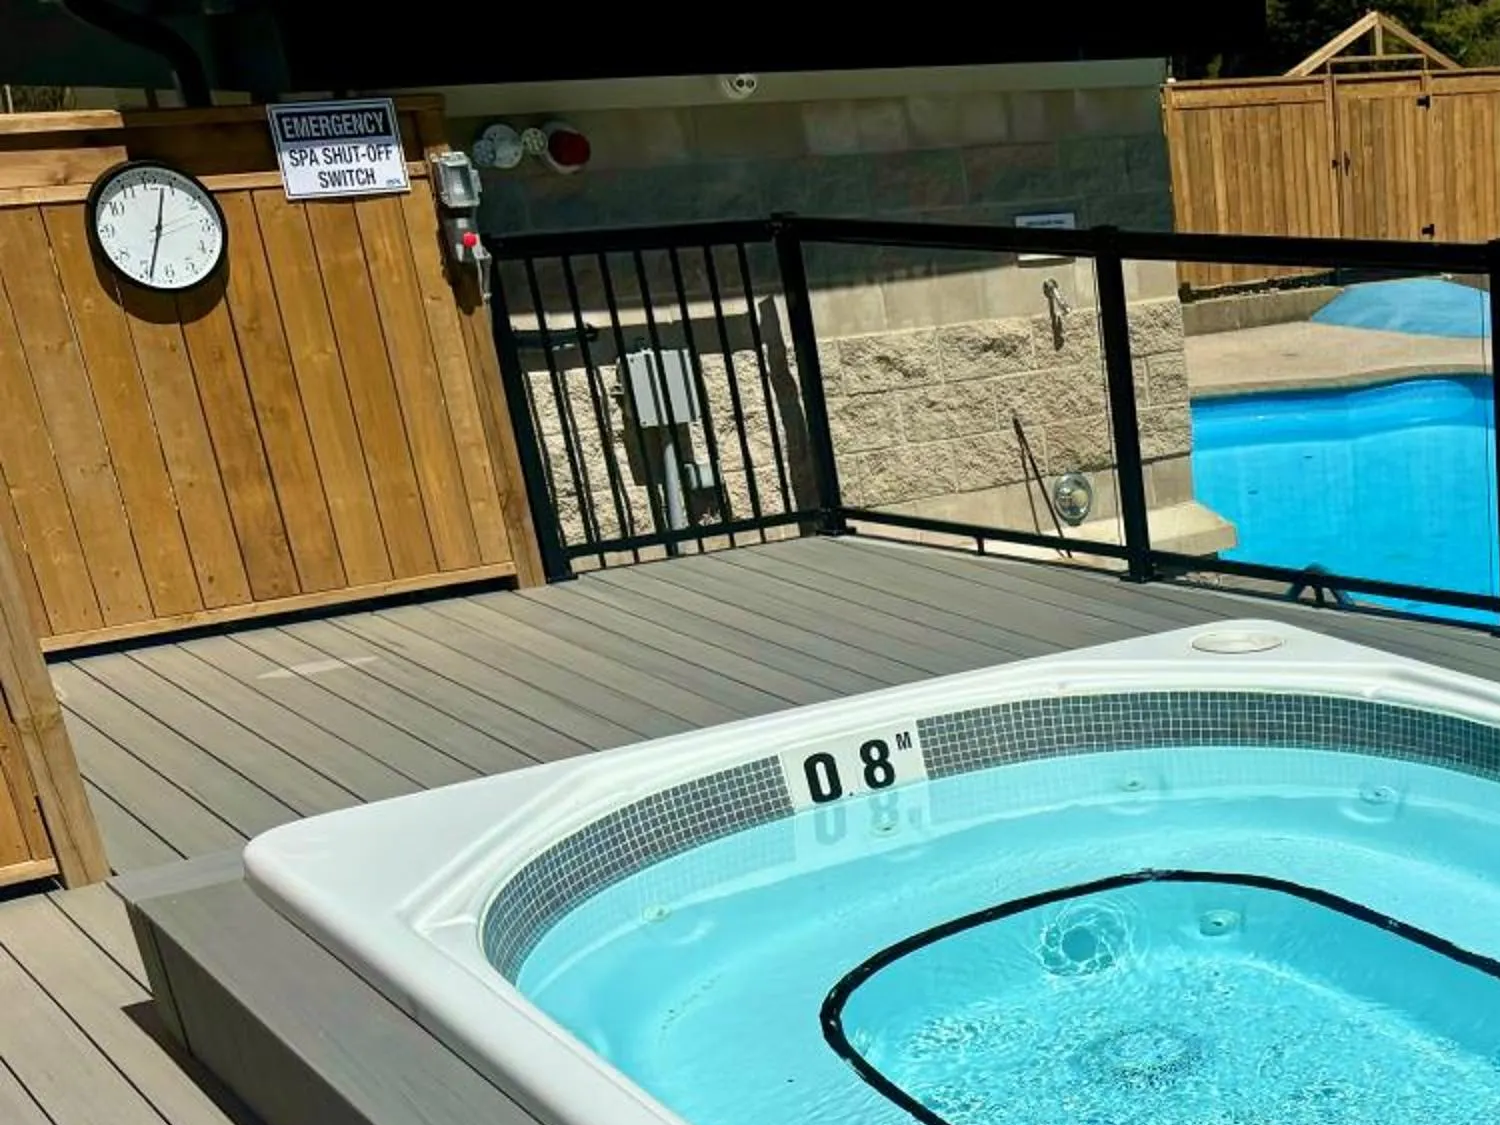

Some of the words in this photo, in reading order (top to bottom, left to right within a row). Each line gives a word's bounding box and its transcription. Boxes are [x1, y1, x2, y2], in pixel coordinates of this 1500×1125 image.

[281, 112, 384, 138] EMERGENCY
[289, 148, 319, 167] SPA
[324, 144, 393, 165] SHUT-OFF
[318, 168, 376, 188] SWITCH
